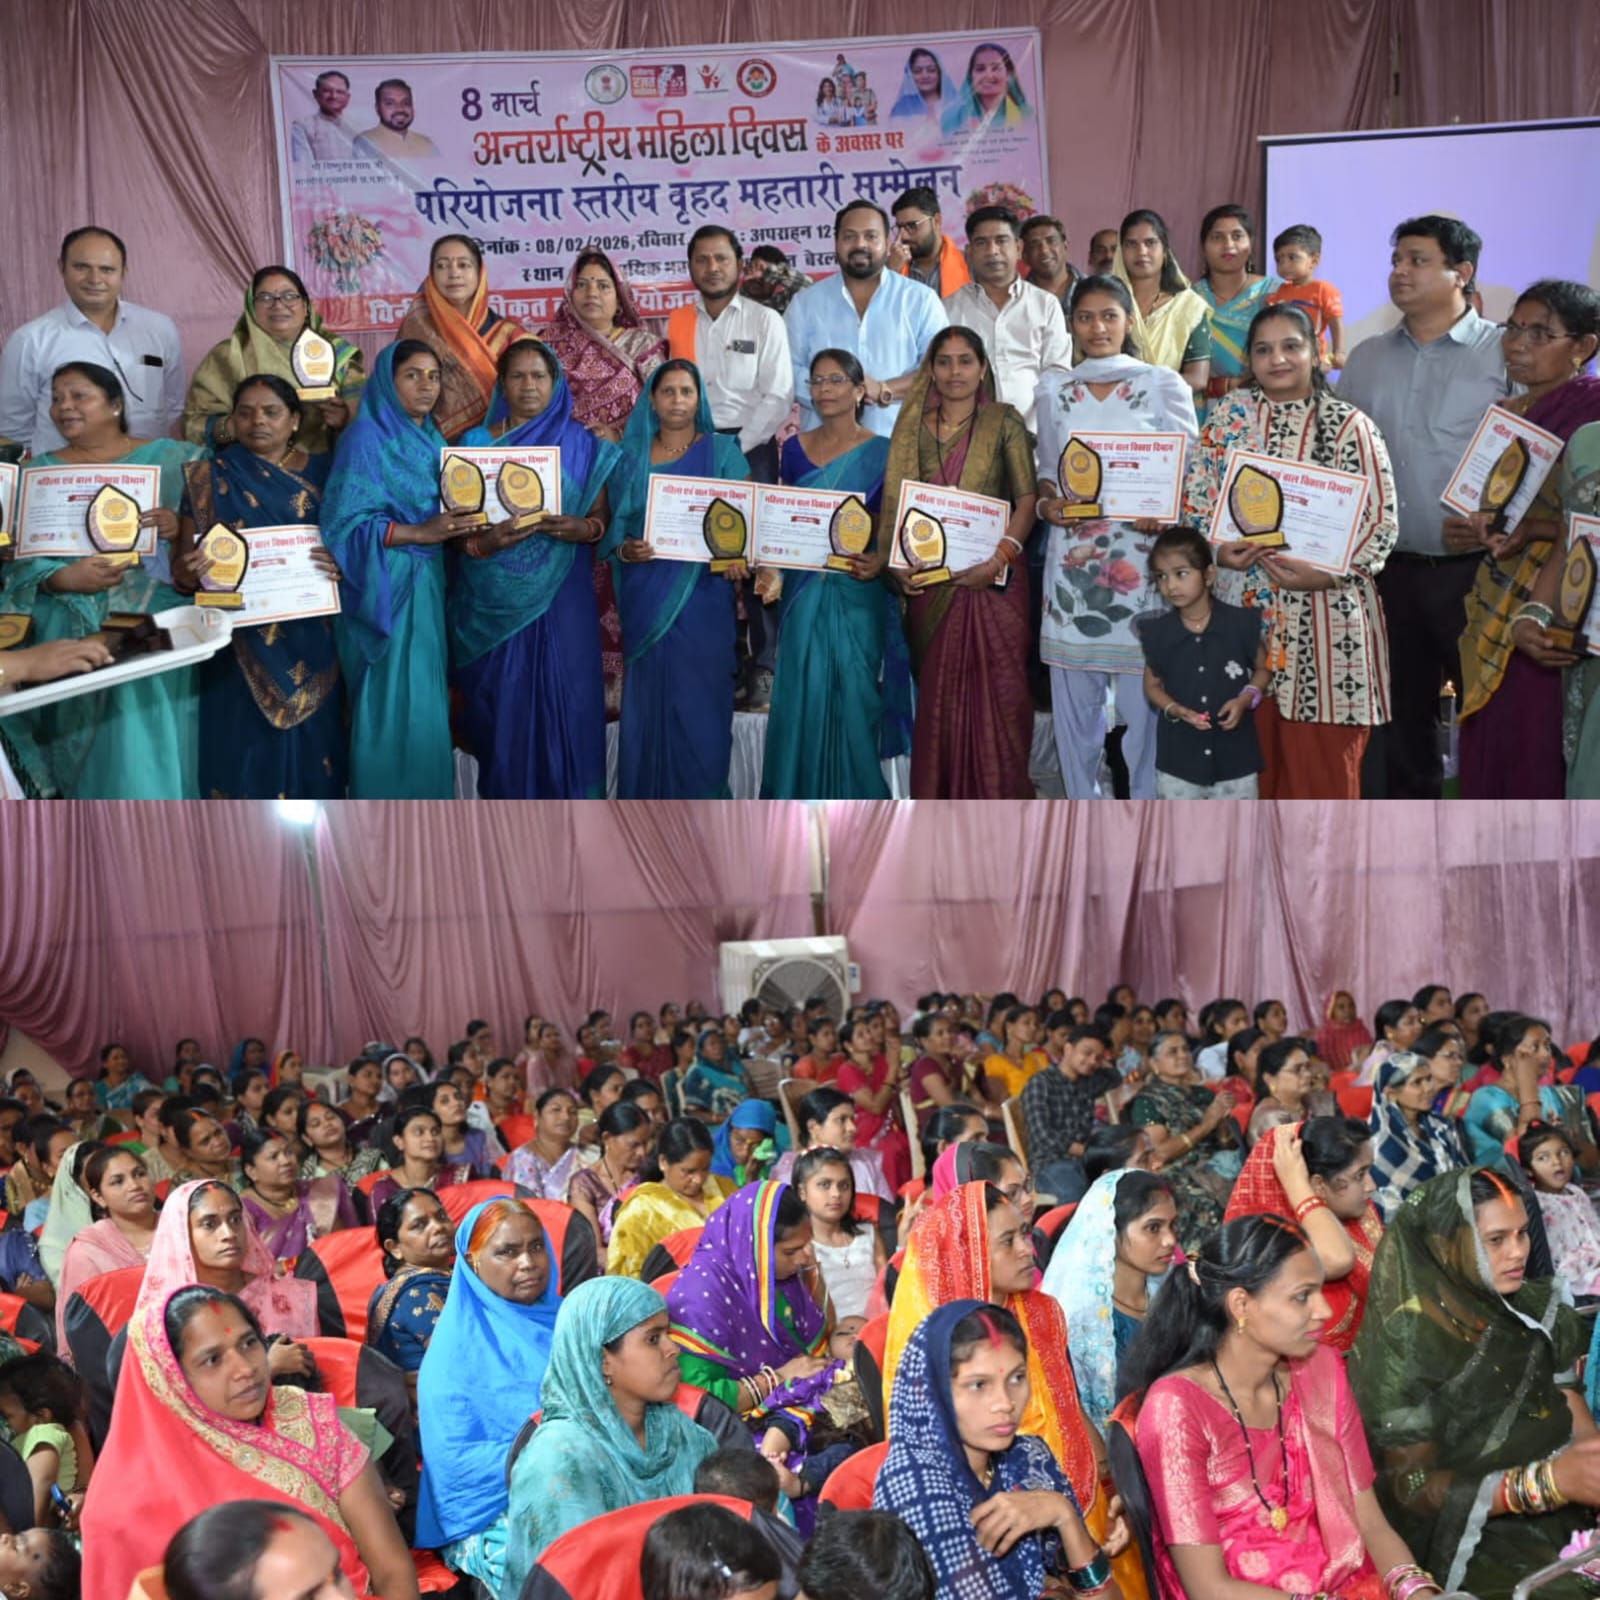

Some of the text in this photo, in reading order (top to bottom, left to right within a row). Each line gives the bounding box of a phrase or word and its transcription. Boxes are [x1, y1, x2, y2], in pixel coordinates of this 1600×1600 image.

[462, 80, 542, 122] 8 मार्च
[473, 105, 809, 178] अन्तर्राष्ट्रीय महिला दिवस
[816, 131, 904, 154] के अवसर पर
[414, 158, 964, 229] परियोजना स्तरीय वृहद महतारी सम्मेलन
